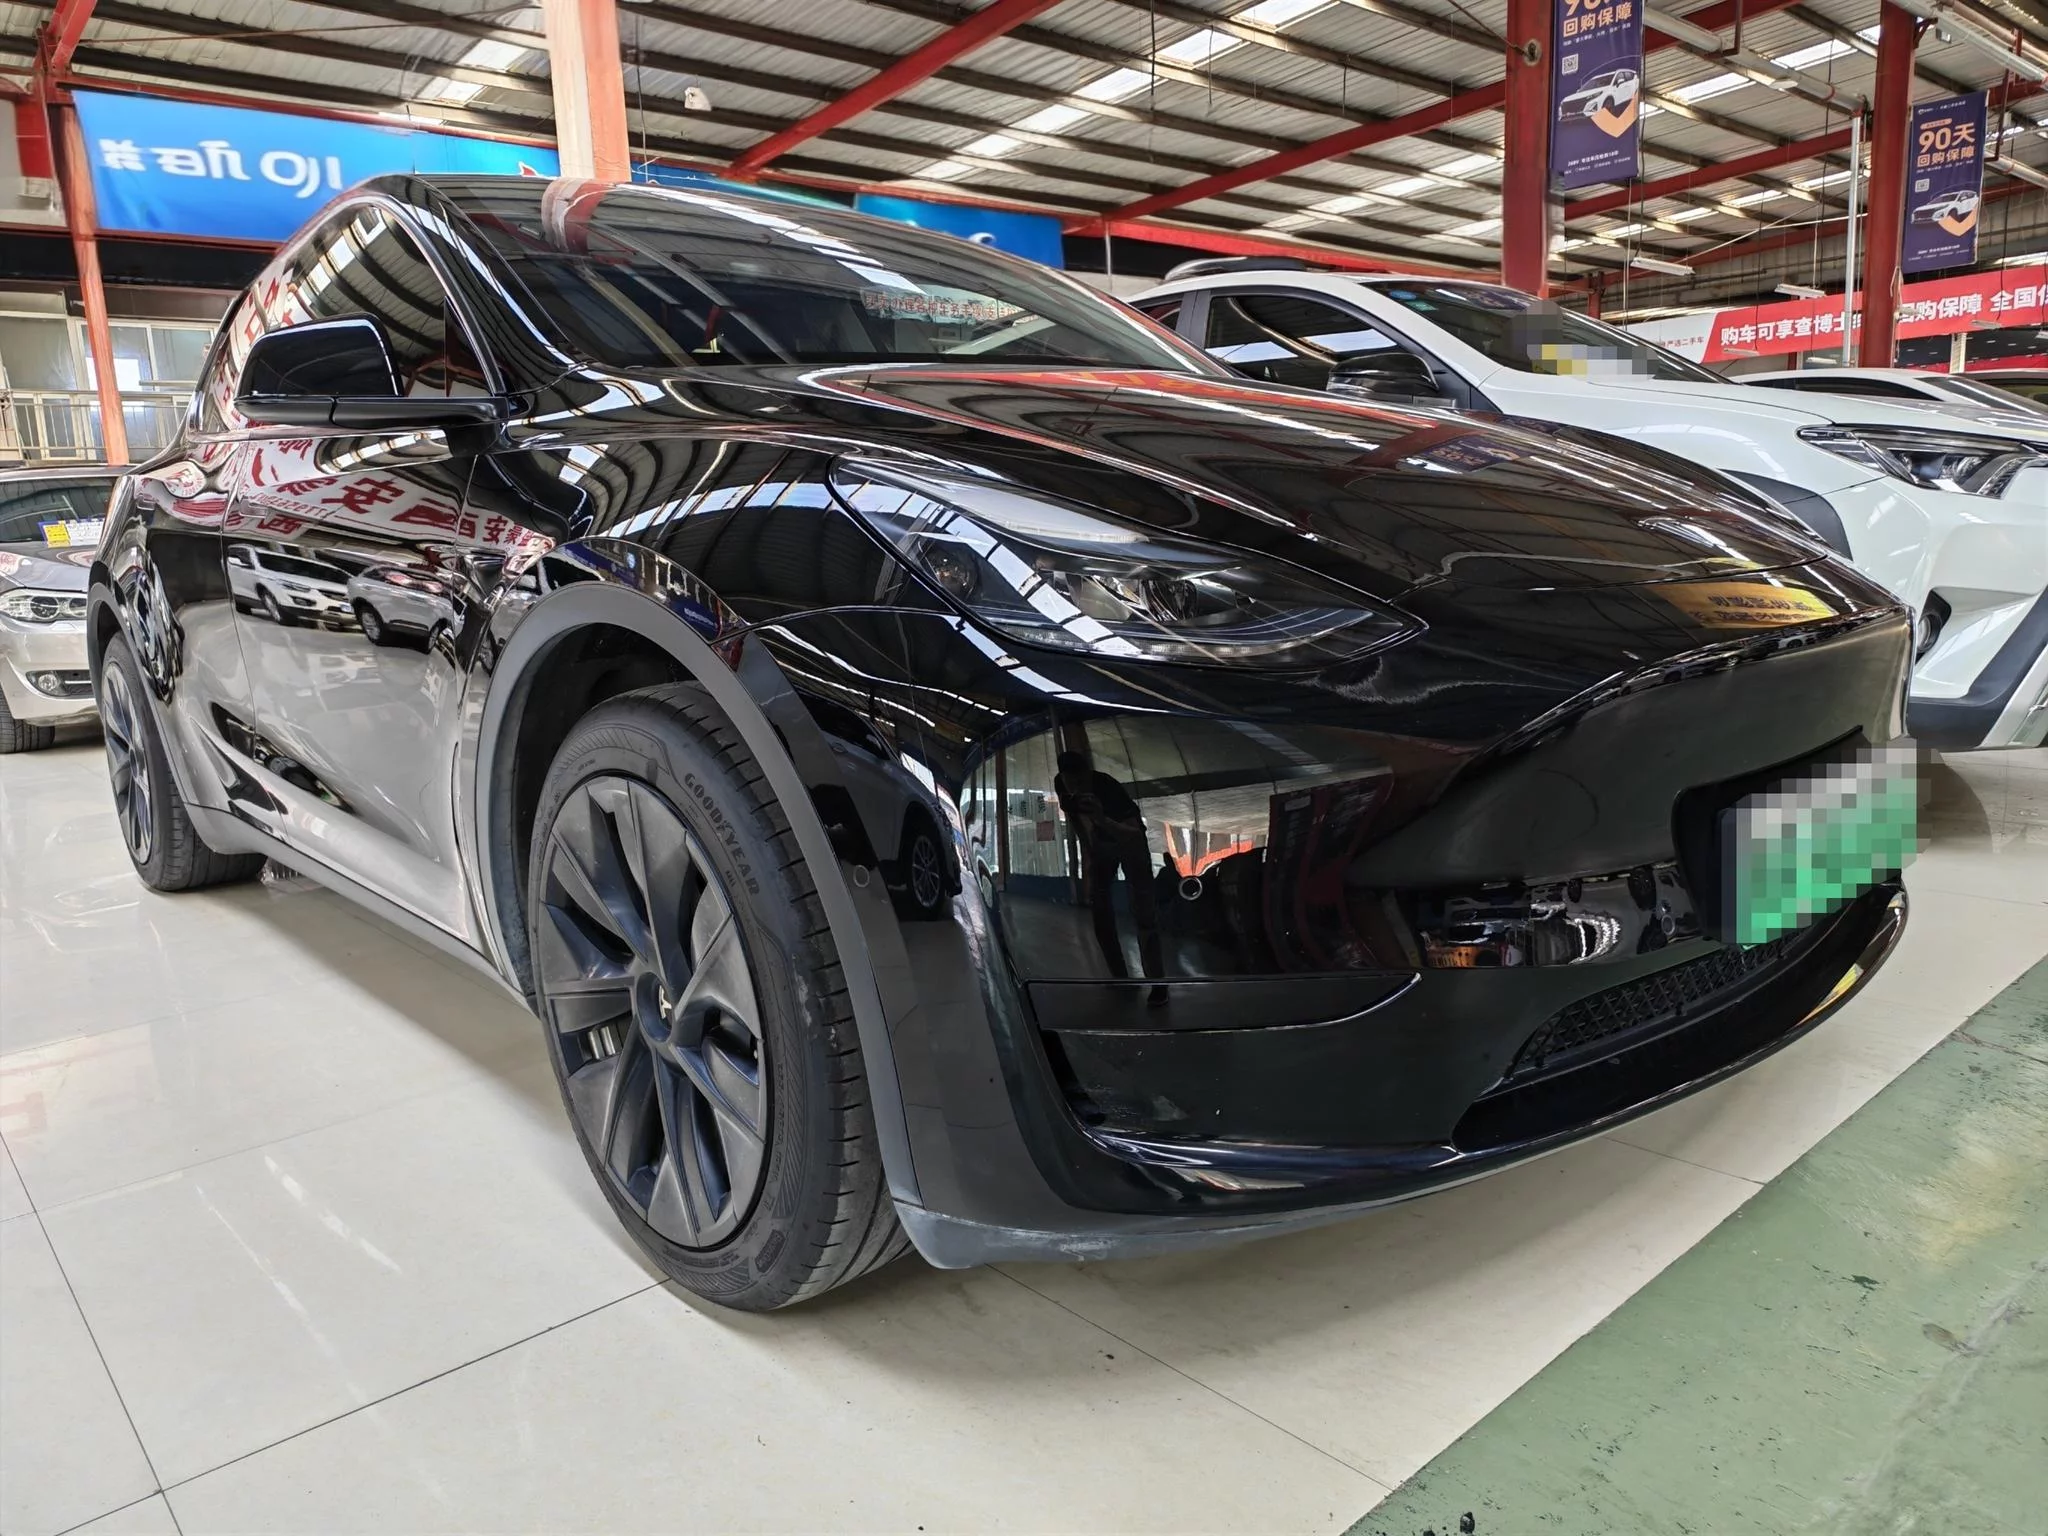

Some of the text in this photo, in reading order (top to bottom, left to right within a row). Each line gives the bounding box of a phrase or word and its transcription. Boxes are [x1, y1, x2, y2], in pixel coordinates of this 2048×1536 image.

[1563, 2, 1632, 37] 回购保障
[1918, 122, 1976, 153] 90天
[1917, 145, 1975, 167] 回购保障
[684, 773, 760, 895] GOODYEAR
